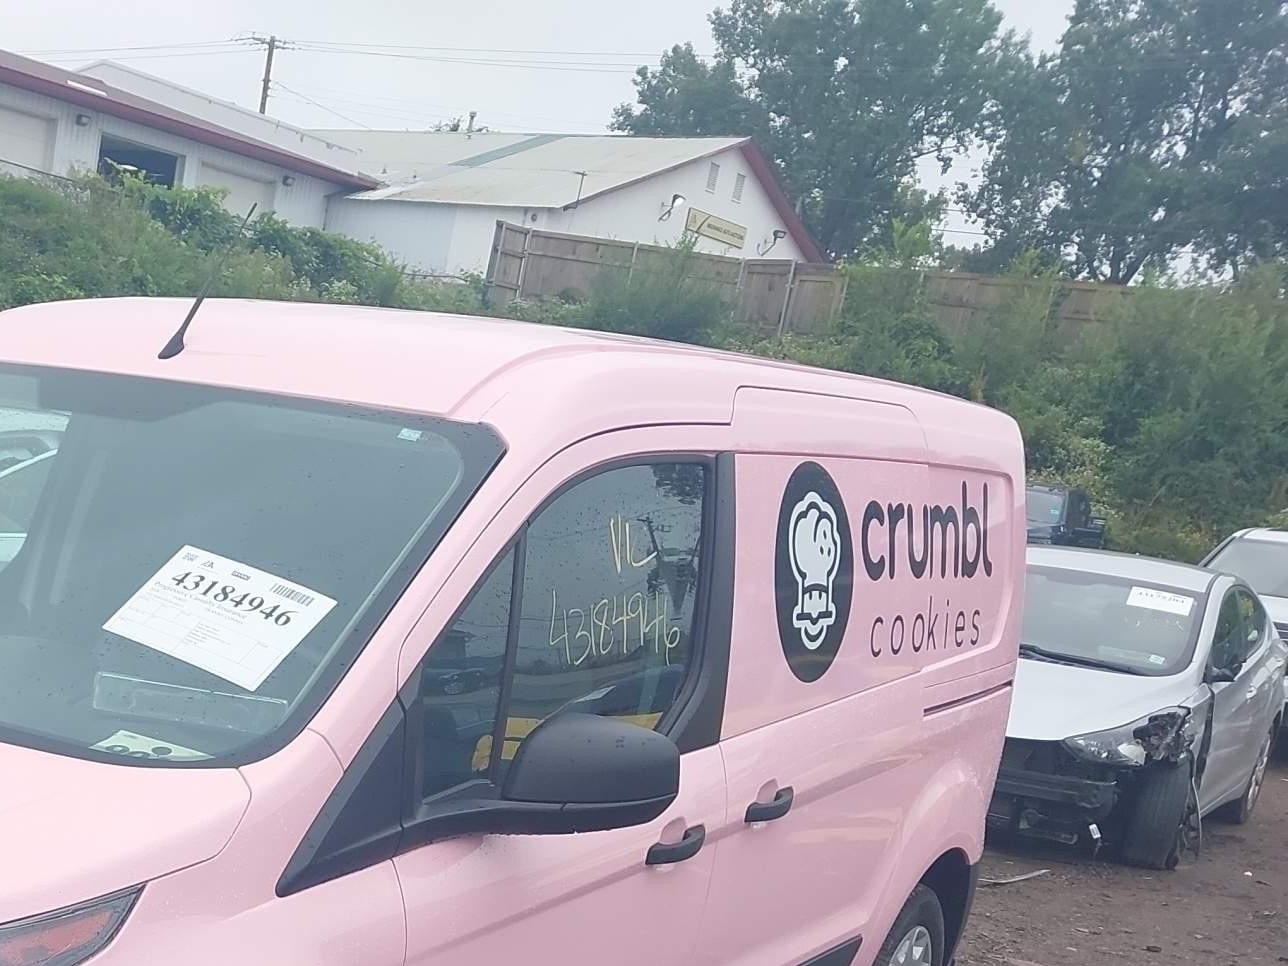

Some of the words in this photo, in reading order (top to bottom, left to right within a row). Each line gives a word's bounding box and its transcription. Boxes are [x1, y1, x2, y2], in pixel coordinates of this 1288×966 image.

[861, 480, 993, 581] crumbl
[171, 570, 299, 627] 43184946
[548, 589, 681, 667] 43184946
[870, 596, 981, 658] cookies
